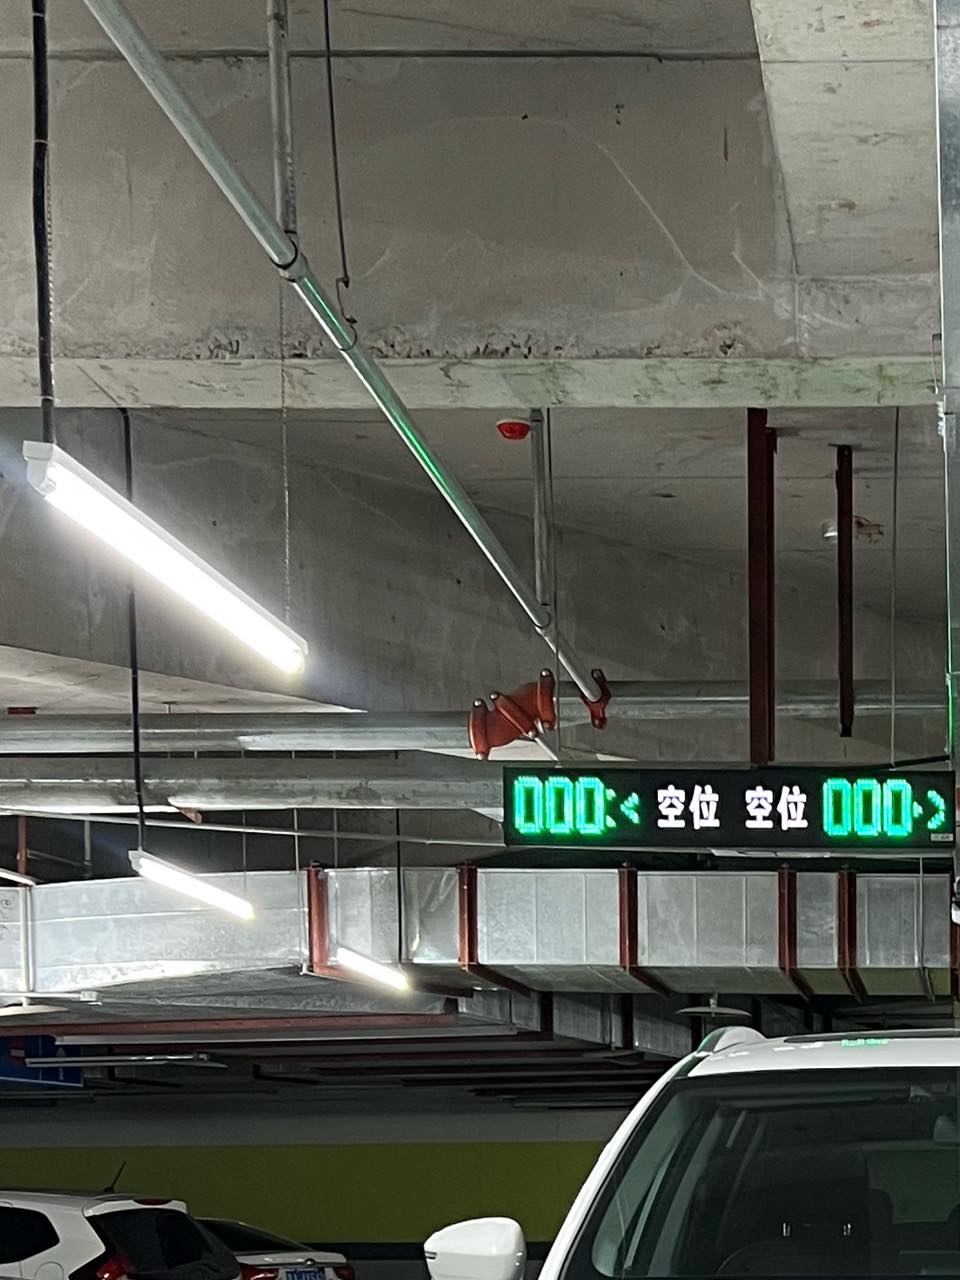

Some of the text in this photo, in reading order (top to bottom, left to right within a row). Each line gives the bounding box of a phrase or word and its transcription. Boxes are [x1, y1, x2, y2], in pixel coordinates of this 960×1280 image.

[513, 776, 913, 836] 000 空位 空位 000
